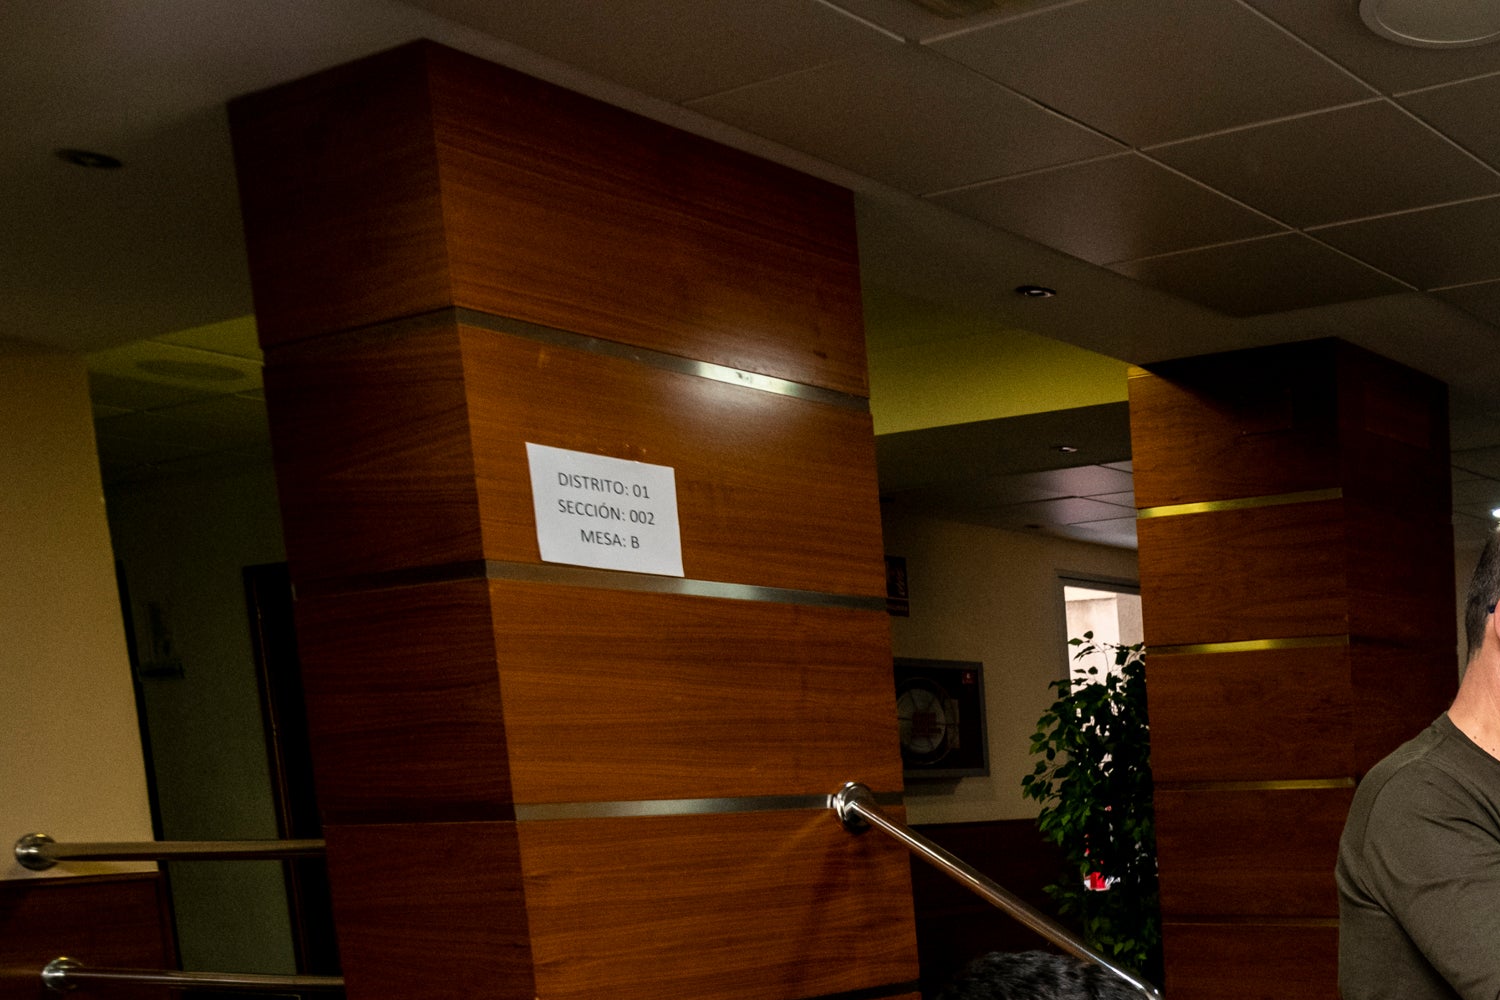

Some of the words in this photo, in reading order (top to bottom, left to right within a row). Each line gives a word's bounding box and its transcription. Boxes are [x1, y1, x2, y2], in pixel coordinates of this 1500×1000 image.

[558, 472, 629, 497] DISTRITO:
[632, 484, 650, 499] 01
[558, 498, 626, 522] SECCIÓN:
[629, 509, 656, 526] 002
[580, 529, 627, 548] MESA:
[630, 535, 640, 549] B
